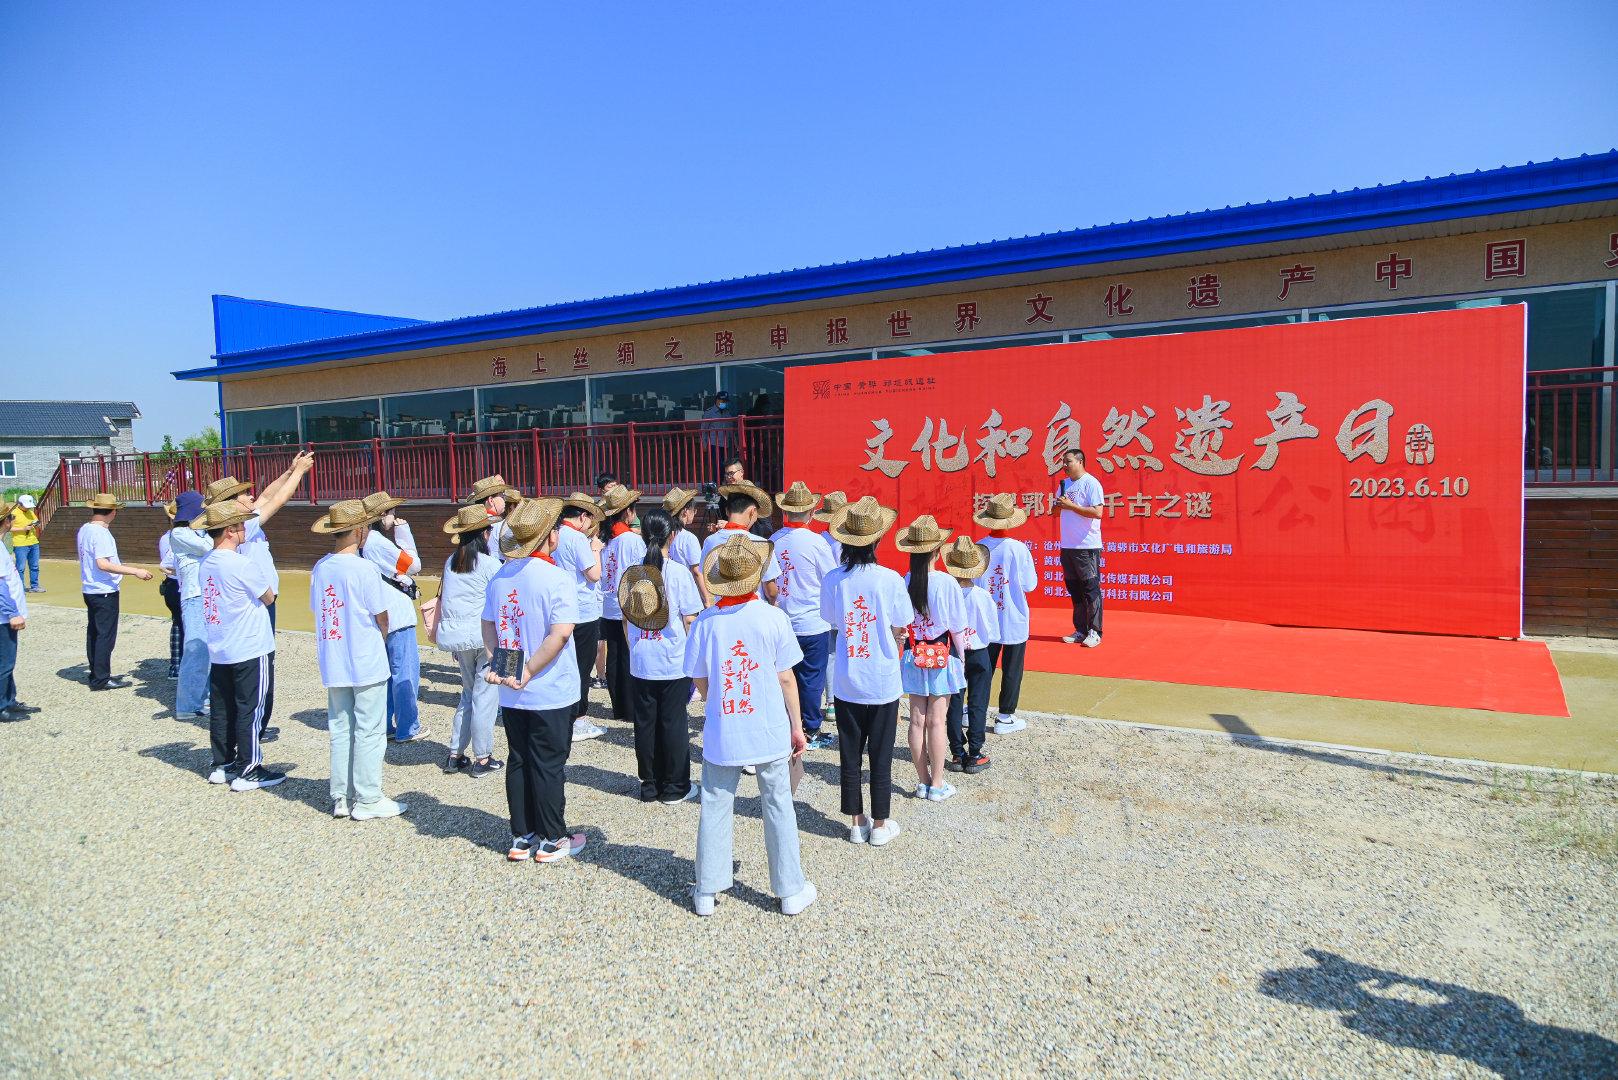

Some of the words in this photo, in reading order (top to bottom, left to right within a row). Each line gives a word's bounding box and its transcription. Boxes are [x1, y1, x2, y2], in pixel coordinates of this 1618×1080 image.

[860, 391, 1394, 478] 文化和自然遗产日
[1350, 476, 1469, 498] 2023.6.10
